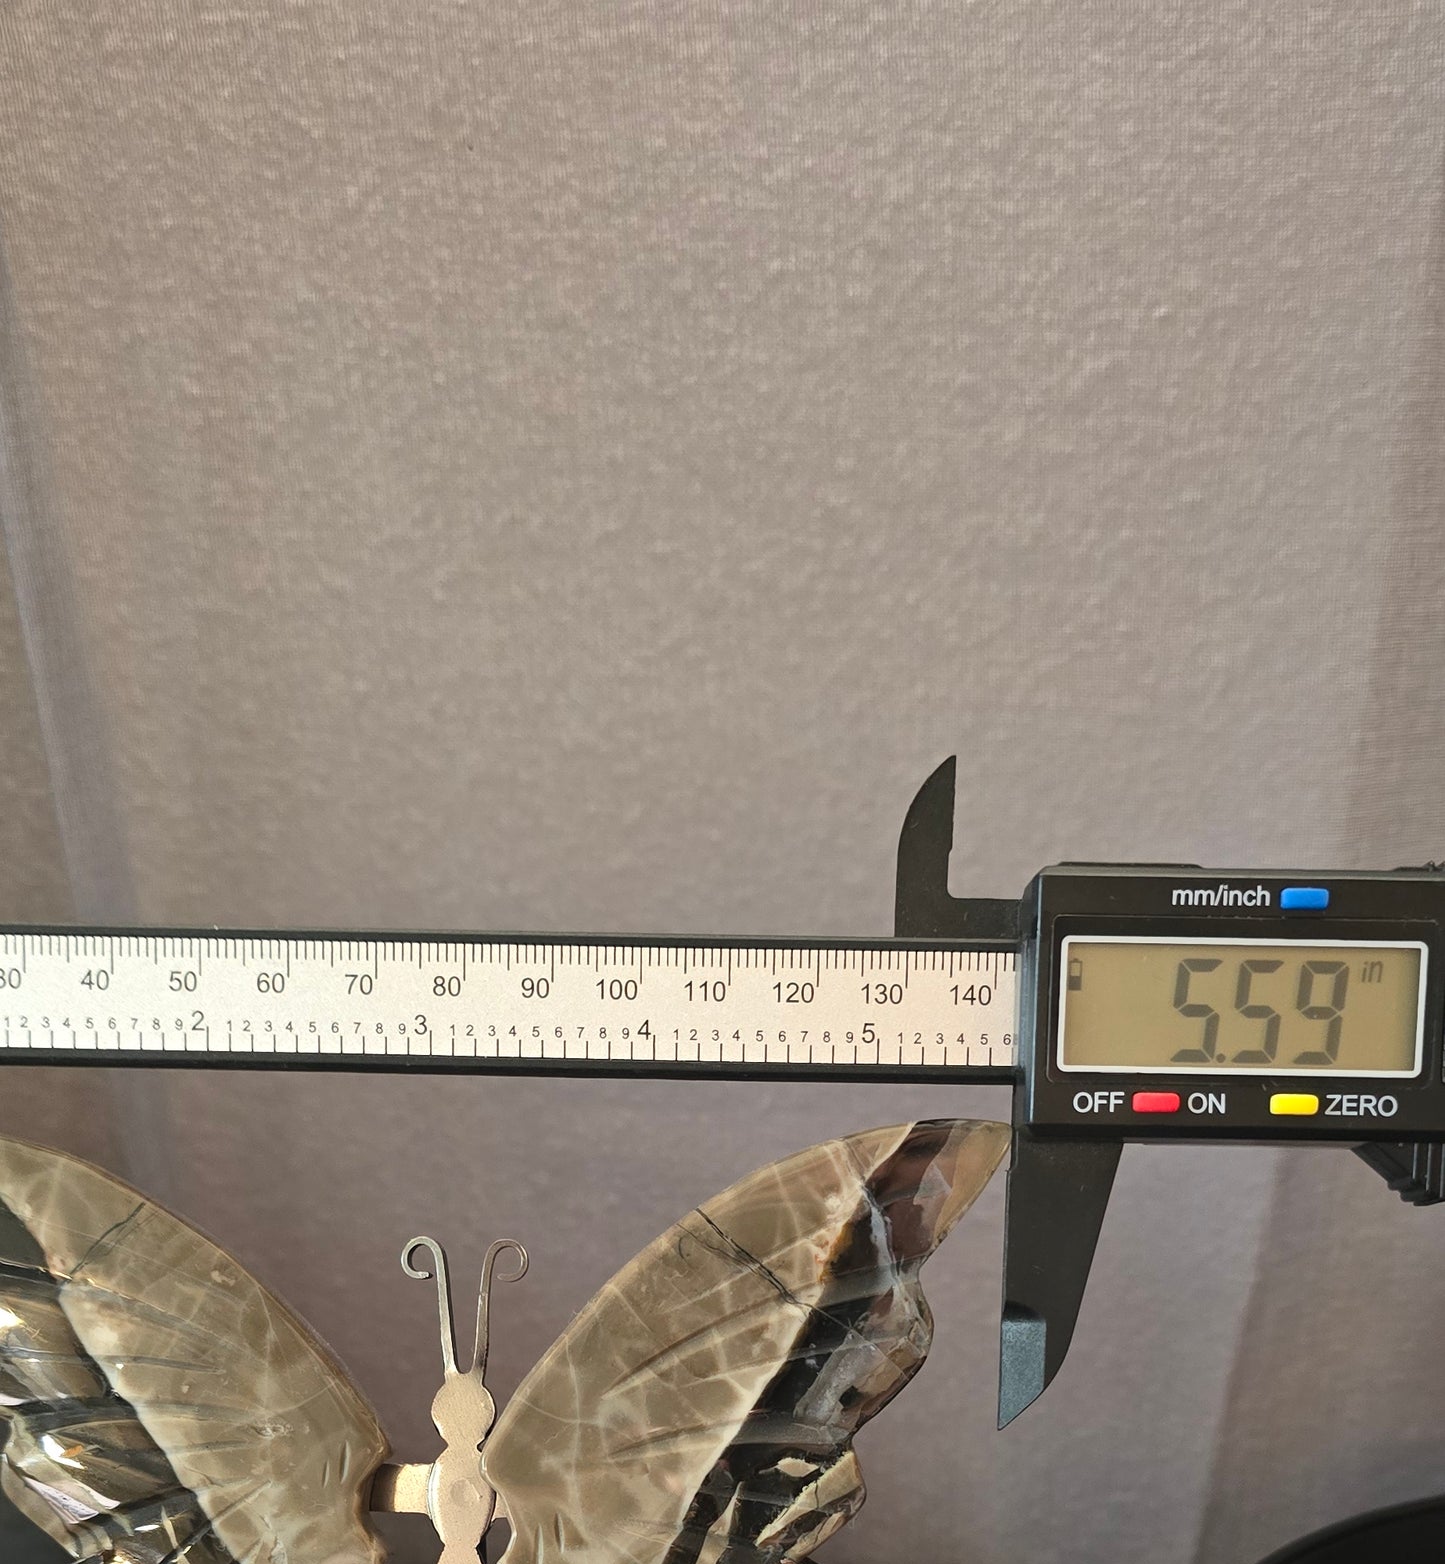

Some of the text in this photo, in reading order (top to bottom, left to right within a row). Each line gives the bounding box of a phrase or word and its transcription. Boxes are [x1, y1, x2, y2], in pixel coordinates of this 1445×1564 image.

[1171, 884, 1271, 907] mm/inch
[79, 968, 110, 991] 40
[168, 970, 198, 993] 50
[256, 971, 286, 994] 60
[344, 973, 374, 996] 70
[432, 975, 462, 998] 80
[520, 976, 550, 1000] 90
[595, 978, 639, 1001] 100
[683, 979, 727, 1003] 110
[772, 981, 815, 1004] 120
[860, 982, 904, 1006] 130
[949, 983, 992, 1007] 140
[3, 1009, 1012, 1046] 1 2 3 4 5 6 7 8 9 2 1 2 3 4 5 6 7 8 9 3 1 2 3 4 5 6 7 8 9 4 1 2 3 4 5 6 7 8 9 5 1 2 3 4 5 6
[1170, 958, 1383, 1064] 5.59 in
[1072, 1091, 1398, 1117] OFF ON ZERO
